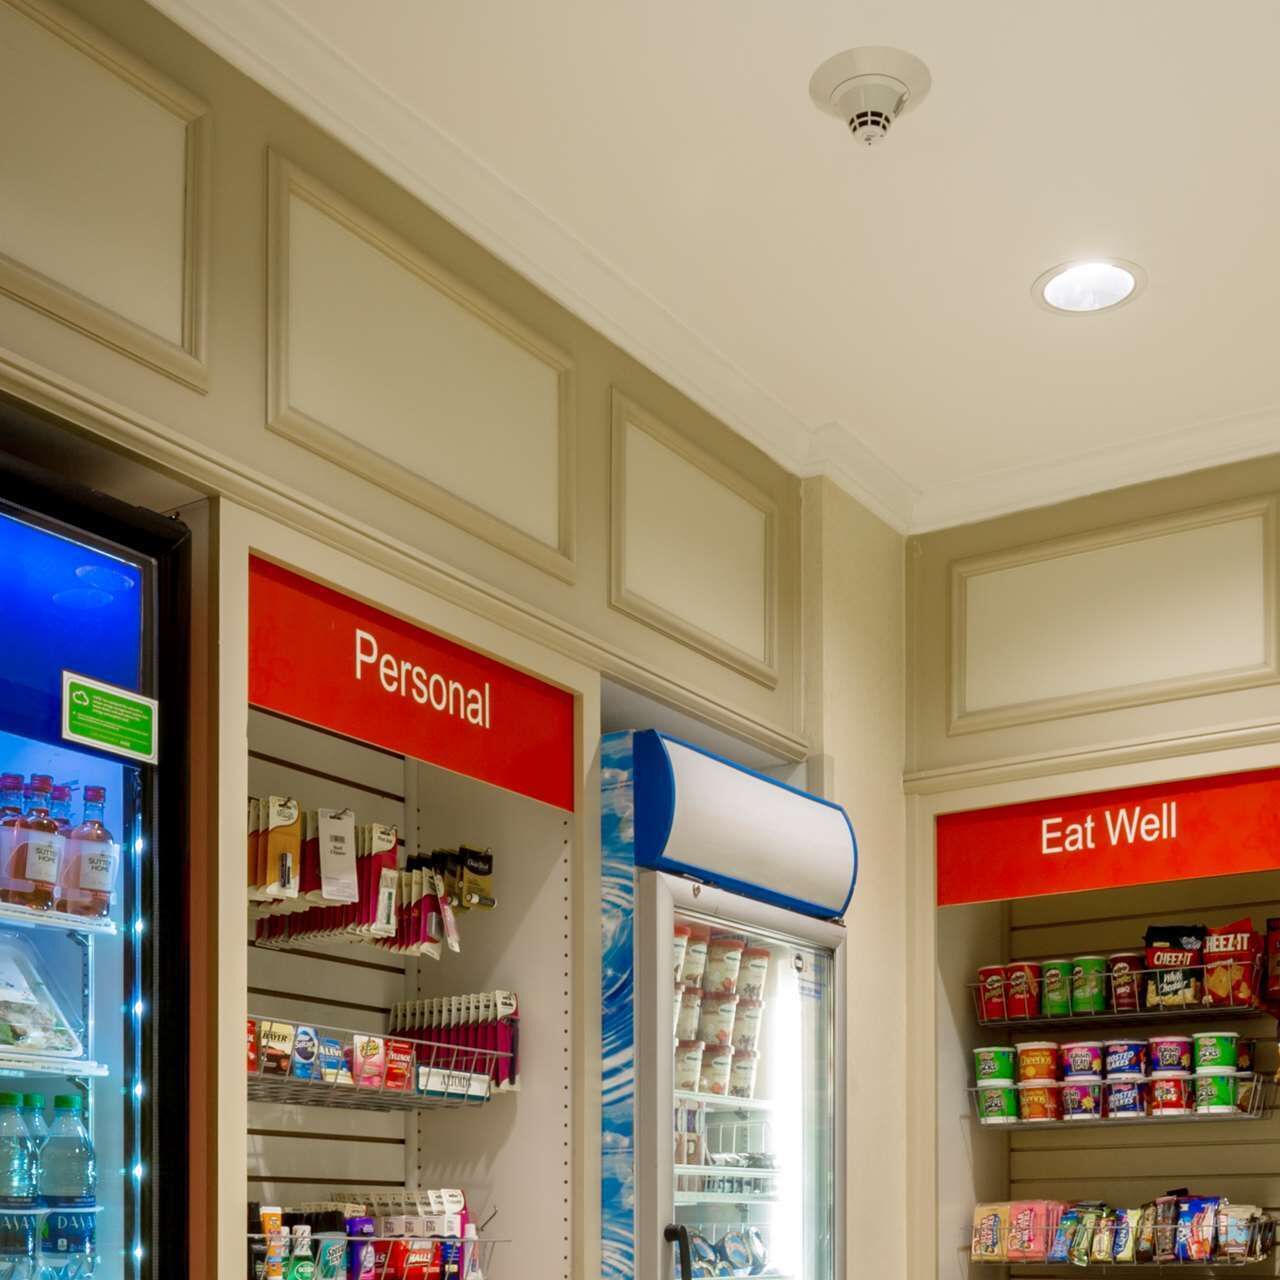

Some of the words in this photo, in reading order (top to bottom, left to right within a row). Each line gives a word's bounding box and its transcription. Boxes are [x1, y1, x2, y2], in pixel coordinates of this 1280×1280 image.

[356, 628, 490, 729] Personal
[1041, 817, 1095, 854] Eat
[1105, 802, 1177, 846] Well
[1205, 933, 1250, 953] HEEZ-IT
[1153, 951, 1193, 966] CHEEZ-IT
[263, 1031, 288, 1043] BAYER
[409, 1253, 431, 1263] HALLS
